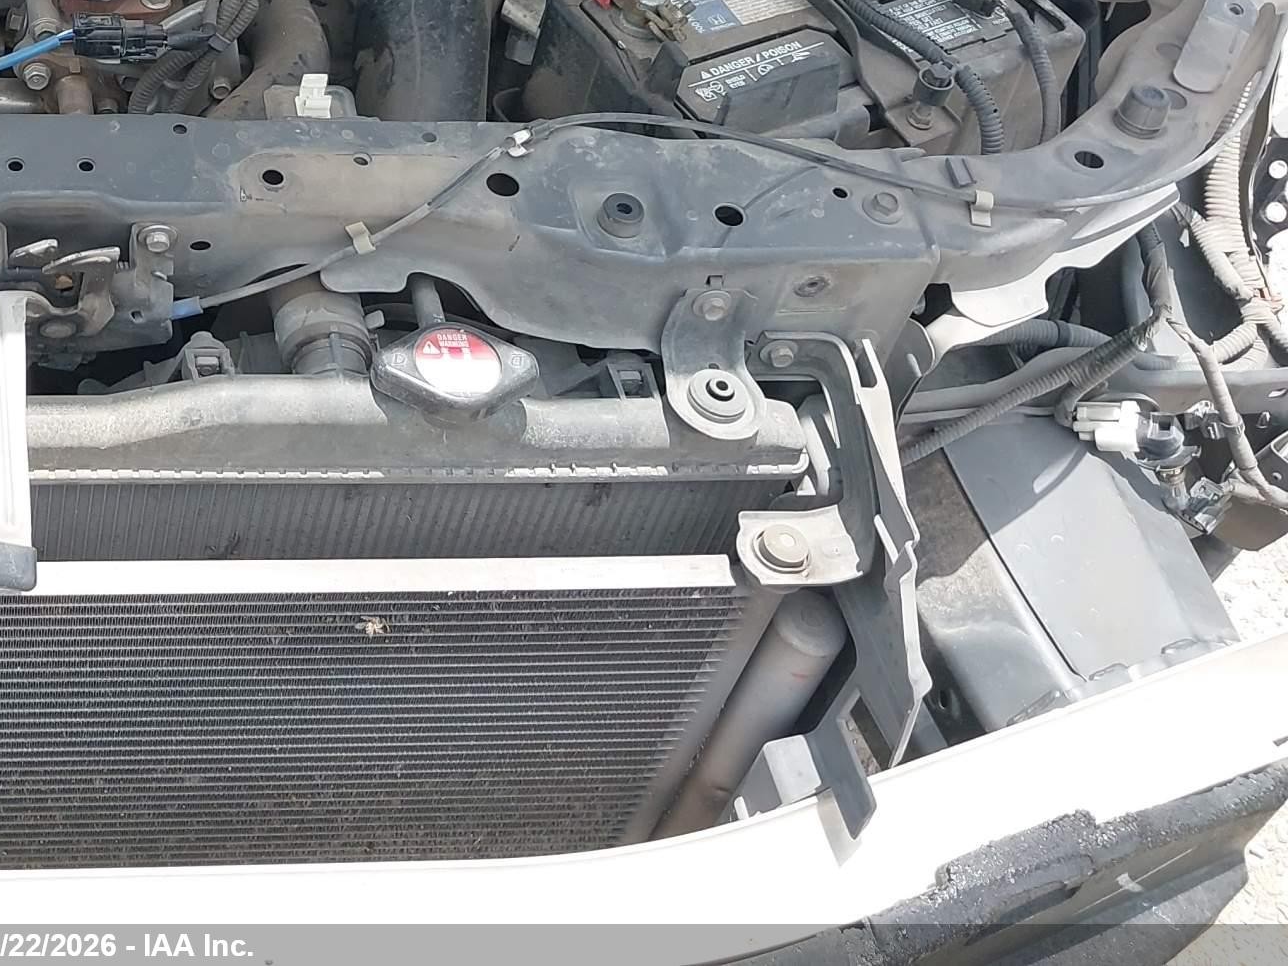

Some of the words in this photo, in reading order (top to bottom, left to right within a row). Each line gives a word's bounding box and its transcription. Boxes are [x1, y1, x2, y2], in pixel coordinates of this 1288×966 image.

[710, 56, 755, 75] DANGER
[761, 41, 802, 59] POISON
[437, 333, 467, 341] DANGER
